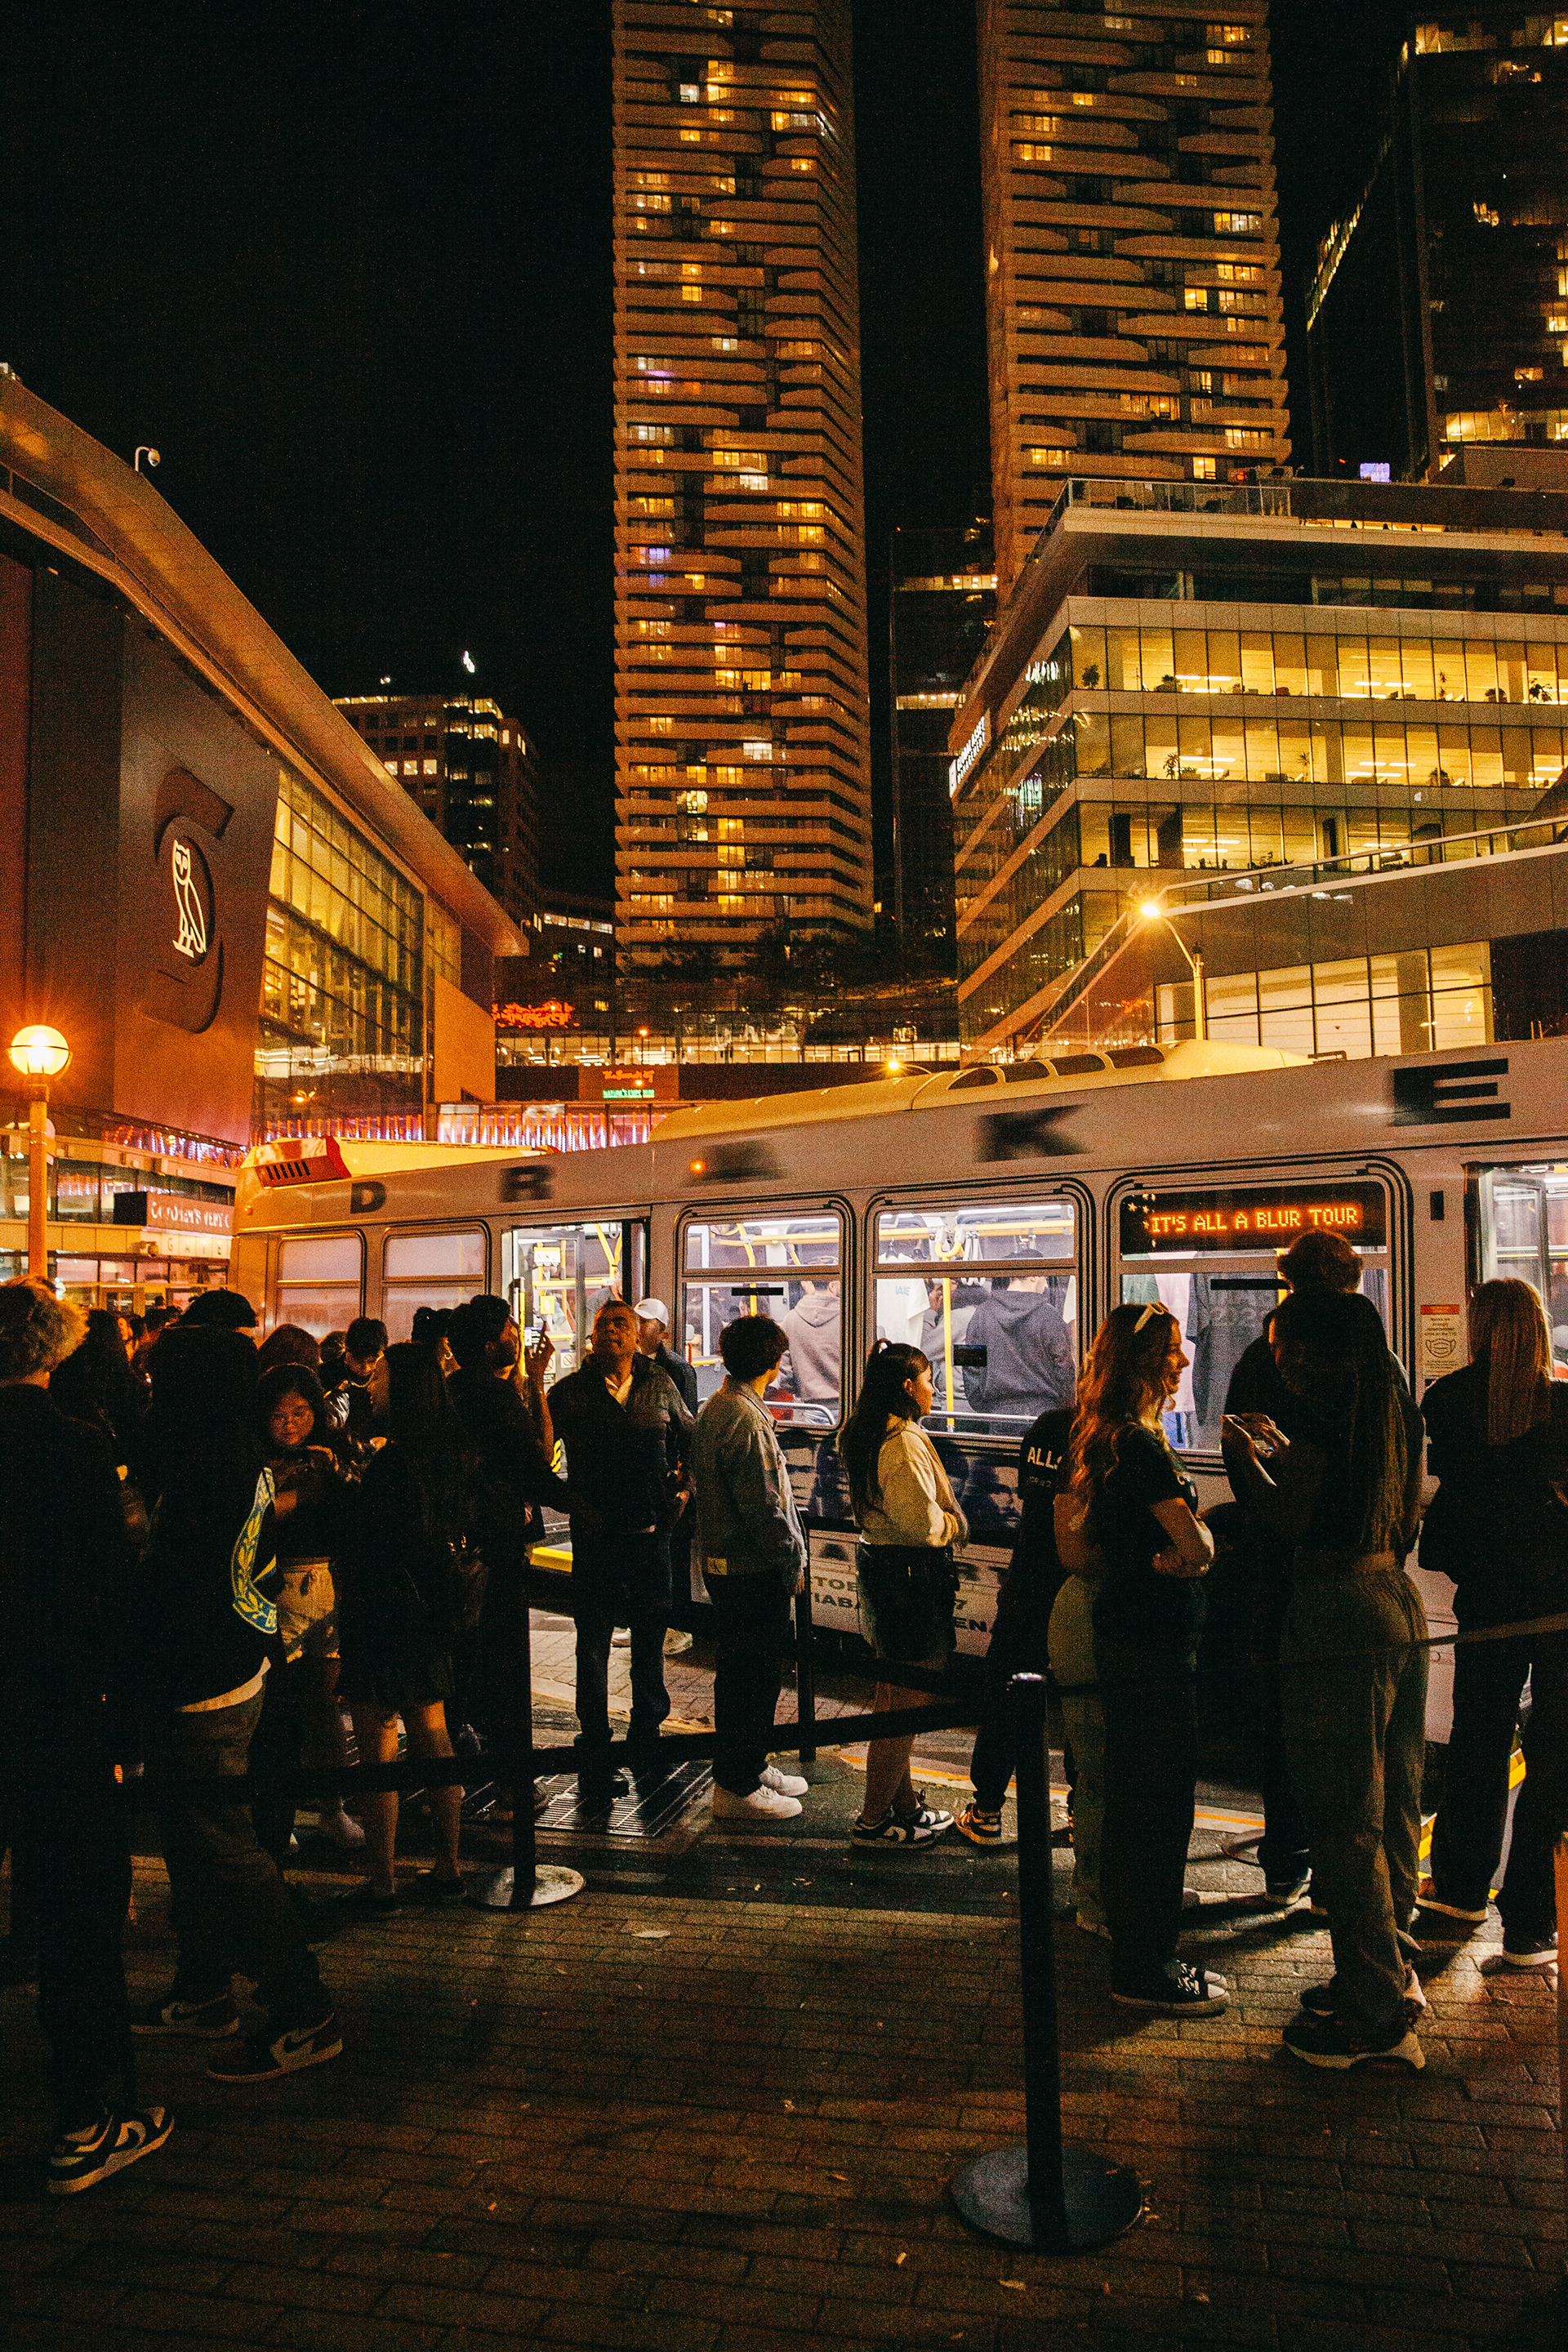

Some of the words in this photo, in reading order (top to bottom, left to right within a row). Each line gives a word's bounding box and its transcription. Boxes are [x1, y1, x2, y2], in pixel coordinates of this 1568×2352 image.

[1152, 1216, 1186, 1233] IT'S
[1194, 1214, 1227, 1231] ALL
[1235, 1213, 1248, 1229] A
[1256, 1209, 1301, 1228] BLUR
[1308, 1207, 1358, 1226] TOUR
[813, 1592, 859, 1609] IAB
[953, 1617, 988, 1632] EN
